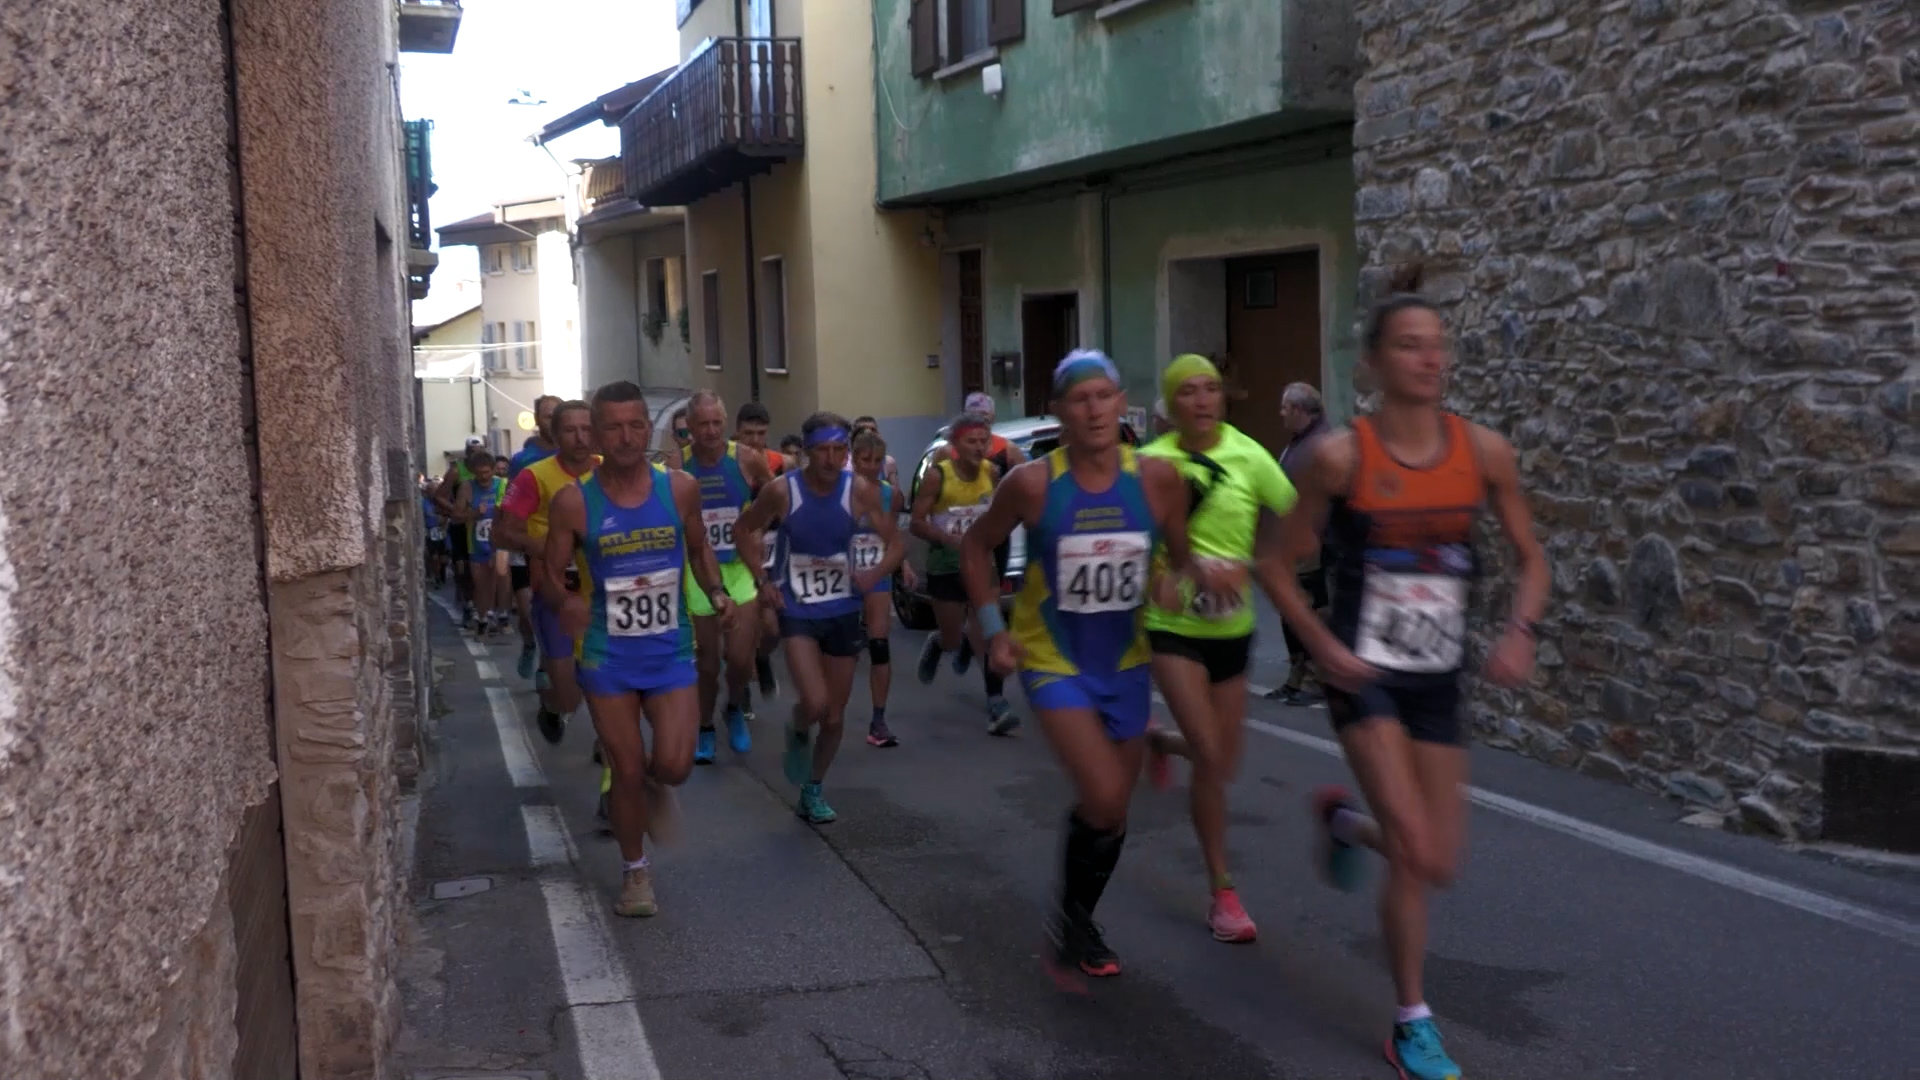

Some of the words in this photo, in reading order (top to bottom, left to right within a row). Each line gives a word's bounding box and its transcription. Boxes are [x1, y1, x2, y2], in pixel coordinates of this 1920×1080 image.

[797, 568, 843, 598] 152
[1067, 560, 1138, 605] 408
[615, 592, 670, 630] 398
